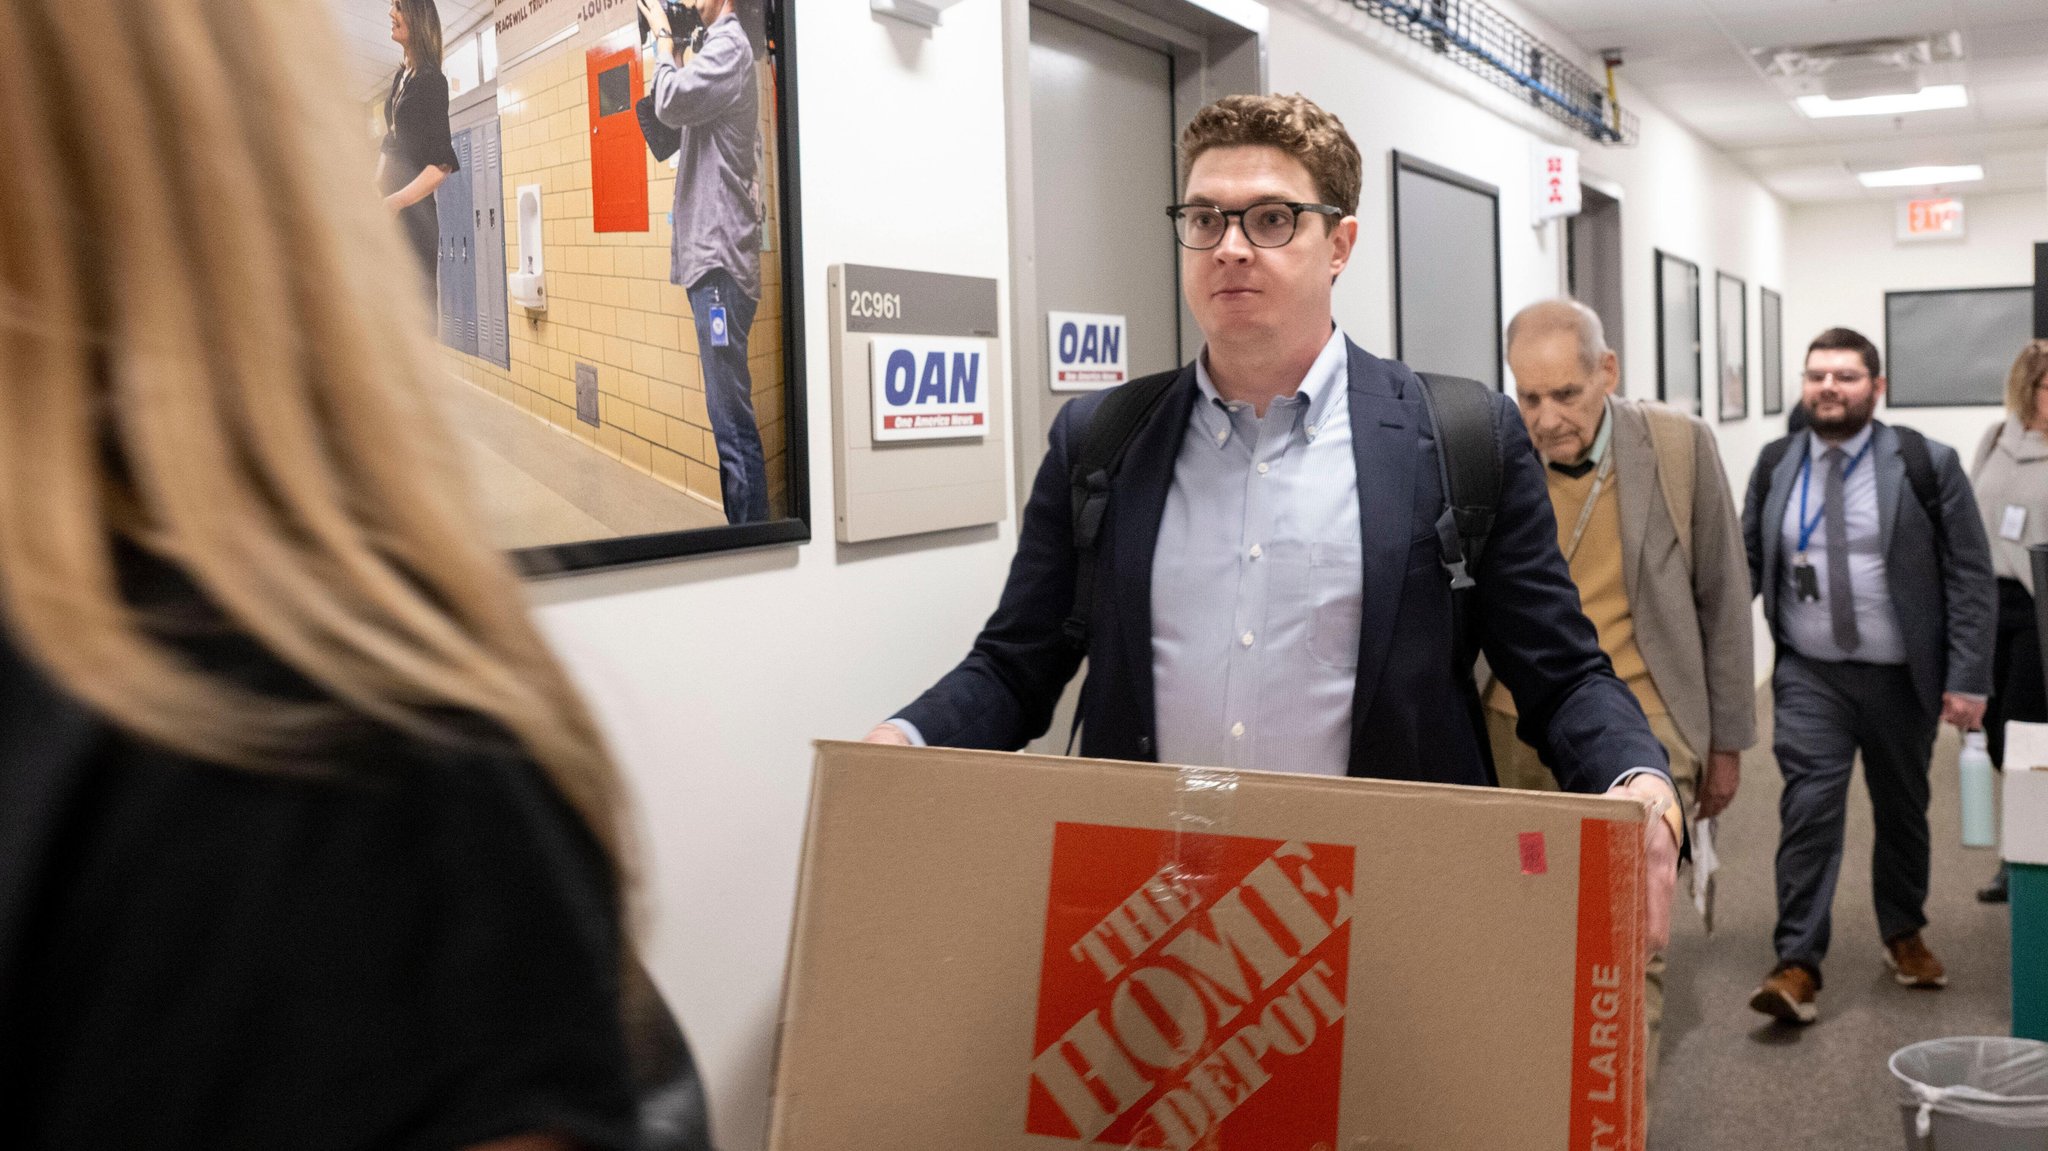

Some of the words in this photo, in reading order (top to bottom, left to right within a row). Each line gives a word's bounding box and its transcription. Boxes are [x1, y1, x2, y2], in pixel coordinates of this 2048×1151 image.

[850, 290, 901, 319] 2C961
[1058, 321, 1121, 365] OAN
[884, 348, 980, 407] OAN
[894, 416, 913, 429] One
[914, 414, 950, 428] America
[950, 413, 974, 427] News
[1070, 862, 1202, 983] THE
[1027, 839, 1354, 1142] HOME
[1587, 964, 1621, 1103] LARGE
[1146, 960, 1347, 1151] DEPOT
